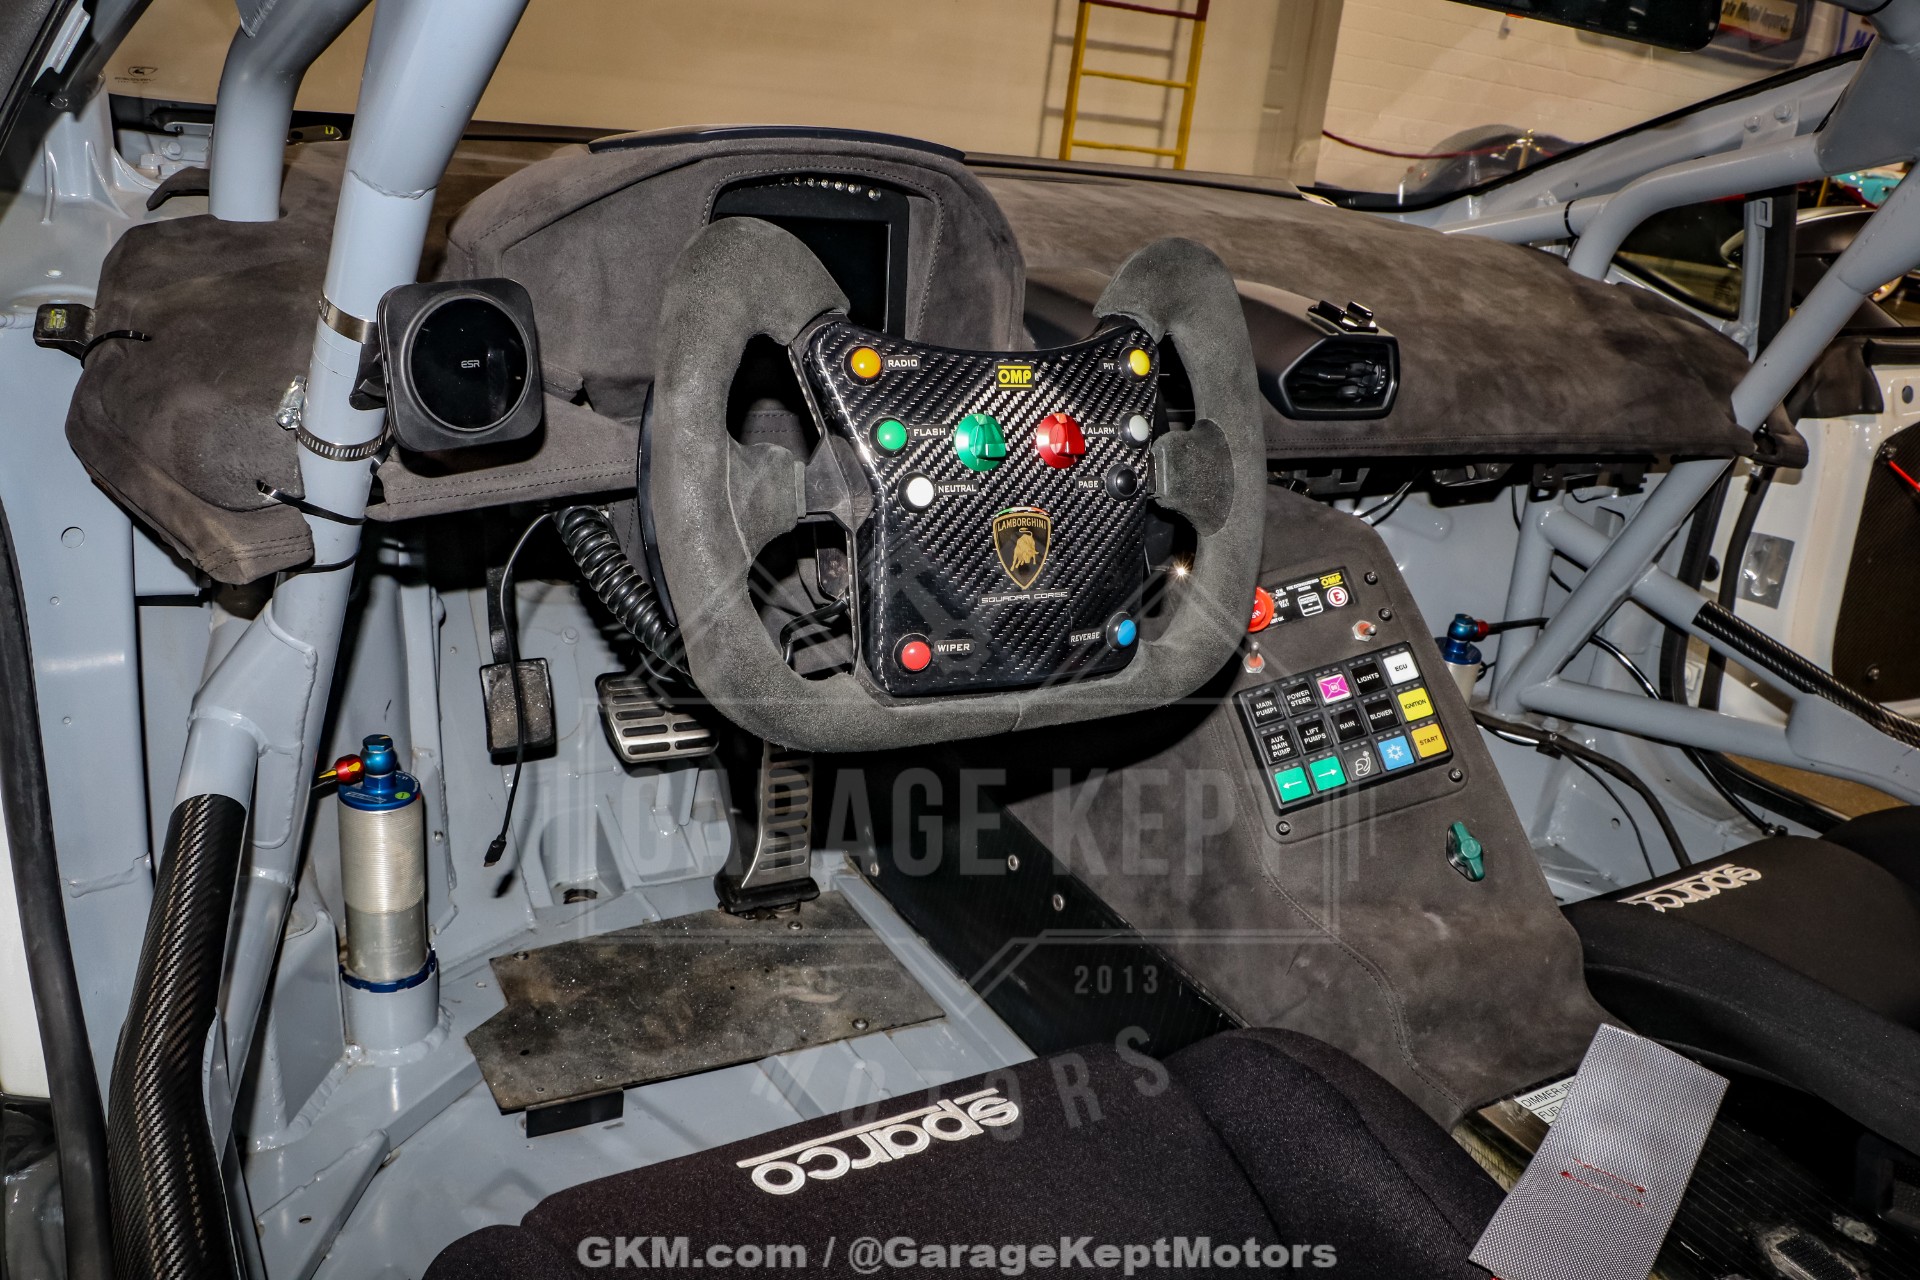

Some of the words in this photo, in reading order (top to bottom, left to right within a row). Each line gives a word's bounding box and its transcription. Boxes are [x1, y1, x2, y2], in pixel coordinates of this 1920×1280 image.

[461, 360, 480, 368] ESR
[888, 359, 918, 368] RADIO
[998, 369, 1032, 384] OMP
[913, 428, 946, 437] FLASH
[1087, 425, 1115, 435] ALARM
[938, 484, 977, 494] NEUTRAL
[1078, 480, 1099, 489] PAGE
[997, 517, 1047, 532] LAMBORGHINI
[1321, 575, 1342, 587] OMP
[981, 594, 1031, 604] SQUADRA
[1033, 591, 1068, 600] CORSE
[1070, 631, 1100, 643] REVERSE
[937, 643, 970, 652] WIPER
[1357, 672, 1380, 683] LIGHTS
[1287, 689, 1310, 701] POWER
[1255, 700, 1273, 709] MAIN
[1290, 696, 1312, 707] STEER
[1404, 699, 1427, 709] IGNITION
[1255, 707, 1278, 717] PUMP1
[1370, 708, 1393, 720] BLOWER
[1339, 720, 1356, 731] RAIN
[1305, 726, 1319, 736] LIFT
[1270, 735, 1285, 744] AUX
[1303, 733, 1327, 744] PUMPS
[1419, 735, 1439, 746] START
[1271, 741, 1288, 750] MAIN
[1272, 747, 1291, 757] PUMP
[736, 1088, 1020, 1195] sparco
